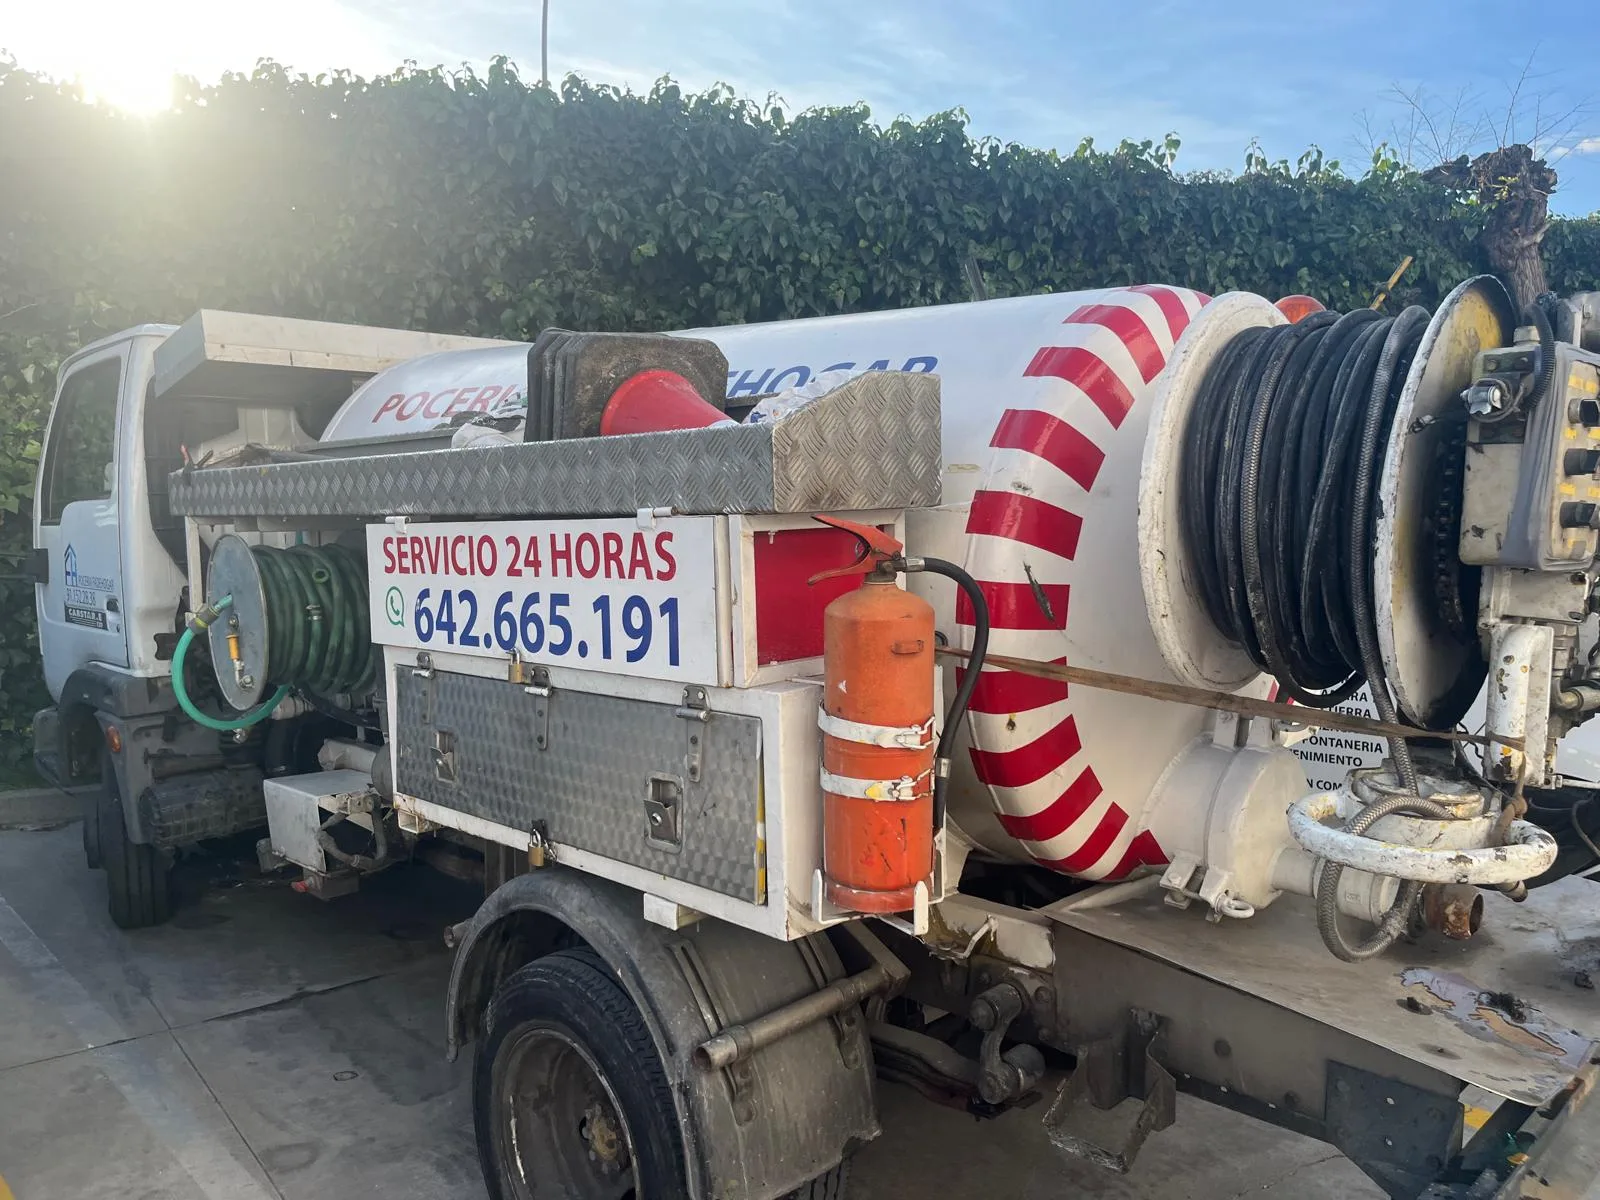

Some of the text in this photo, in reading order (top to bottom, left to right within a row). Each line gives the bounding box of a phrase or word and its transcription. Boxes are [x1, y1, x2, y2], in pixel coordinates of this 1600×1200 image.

[383, 531, 677, 581] SERVICIO 24 HORAS
[414, 588, 680, 666] 642.665.191
[1291, 749, 1362, 767] ENIMIENTO
